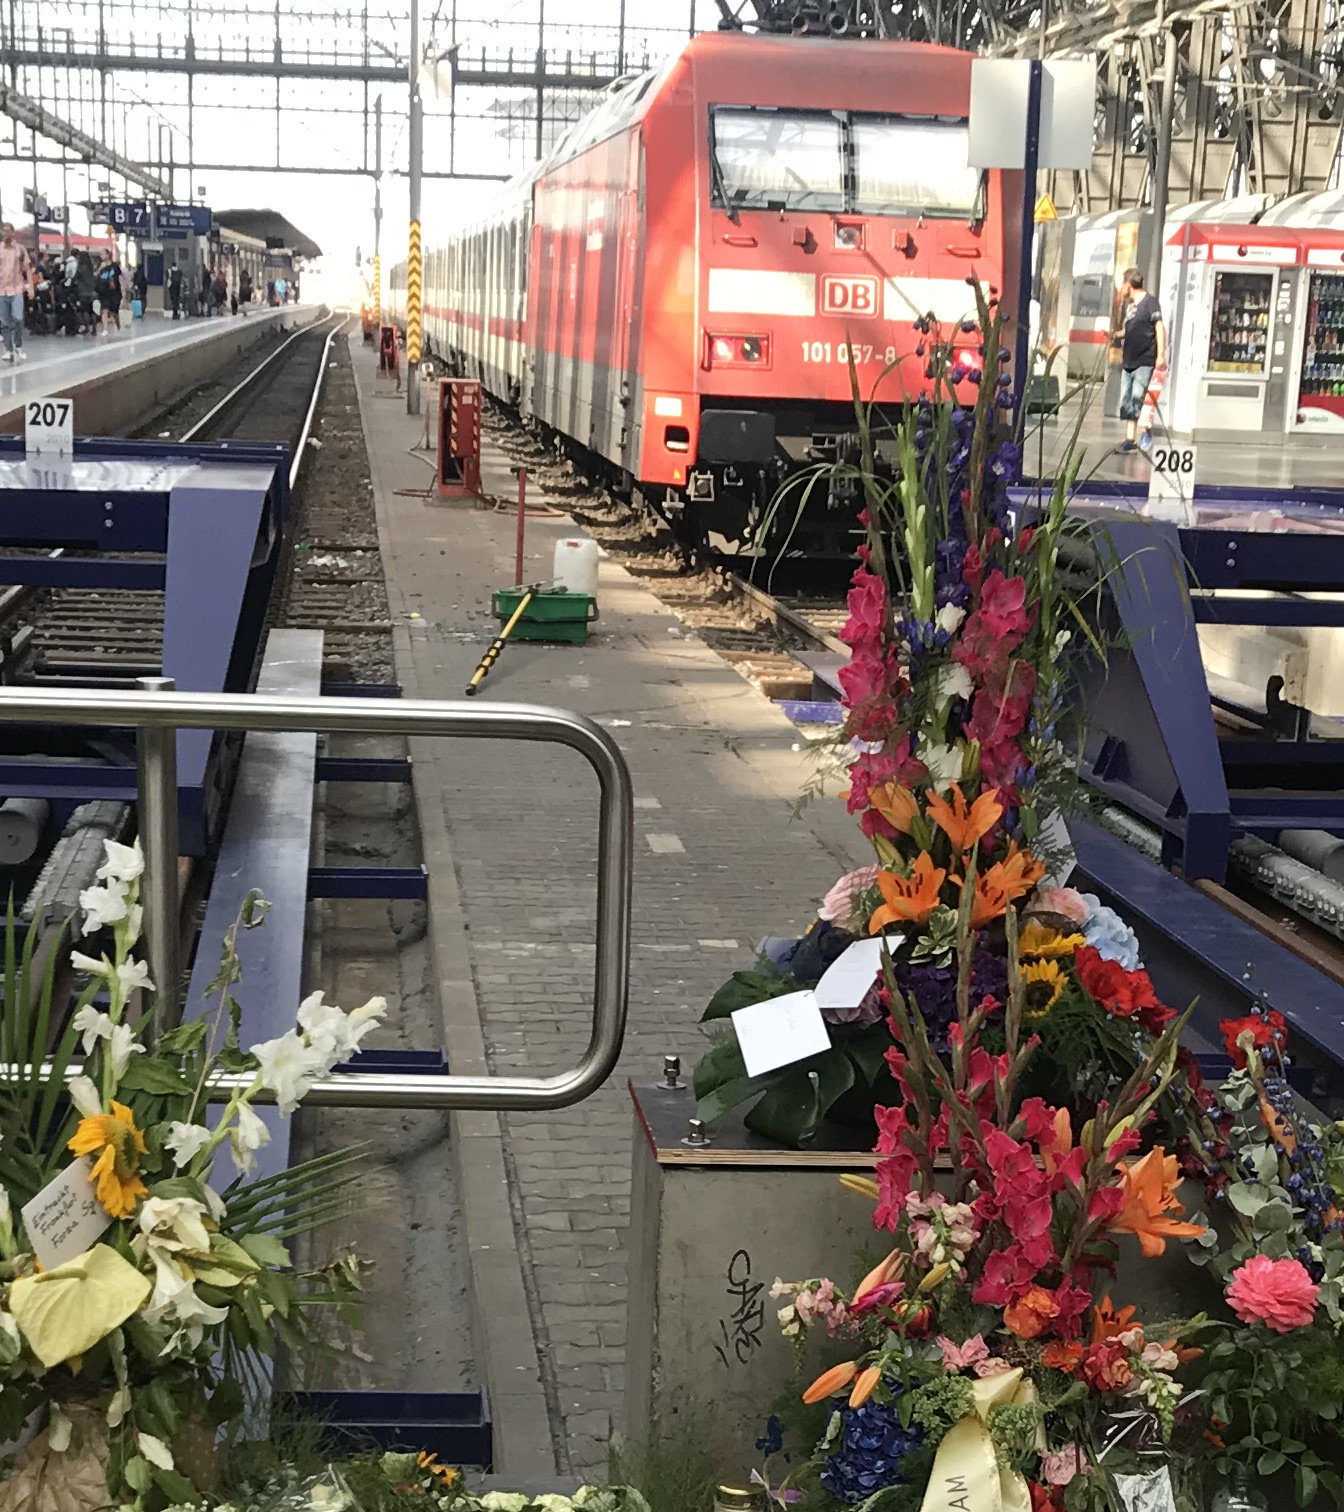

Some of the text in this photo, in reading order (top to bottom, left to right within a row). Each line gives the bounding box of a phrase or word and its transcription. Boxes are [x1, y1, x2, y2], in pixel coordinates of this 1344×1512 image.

[114, 208, 126, 224] B
[133, 208, 144, 224] 7
[828, 281, 871, 311] DB
[801, 341, 832, 364] 101
[28, 402, 70, 427] 207
[1155, 449, 1194, 473] 208
